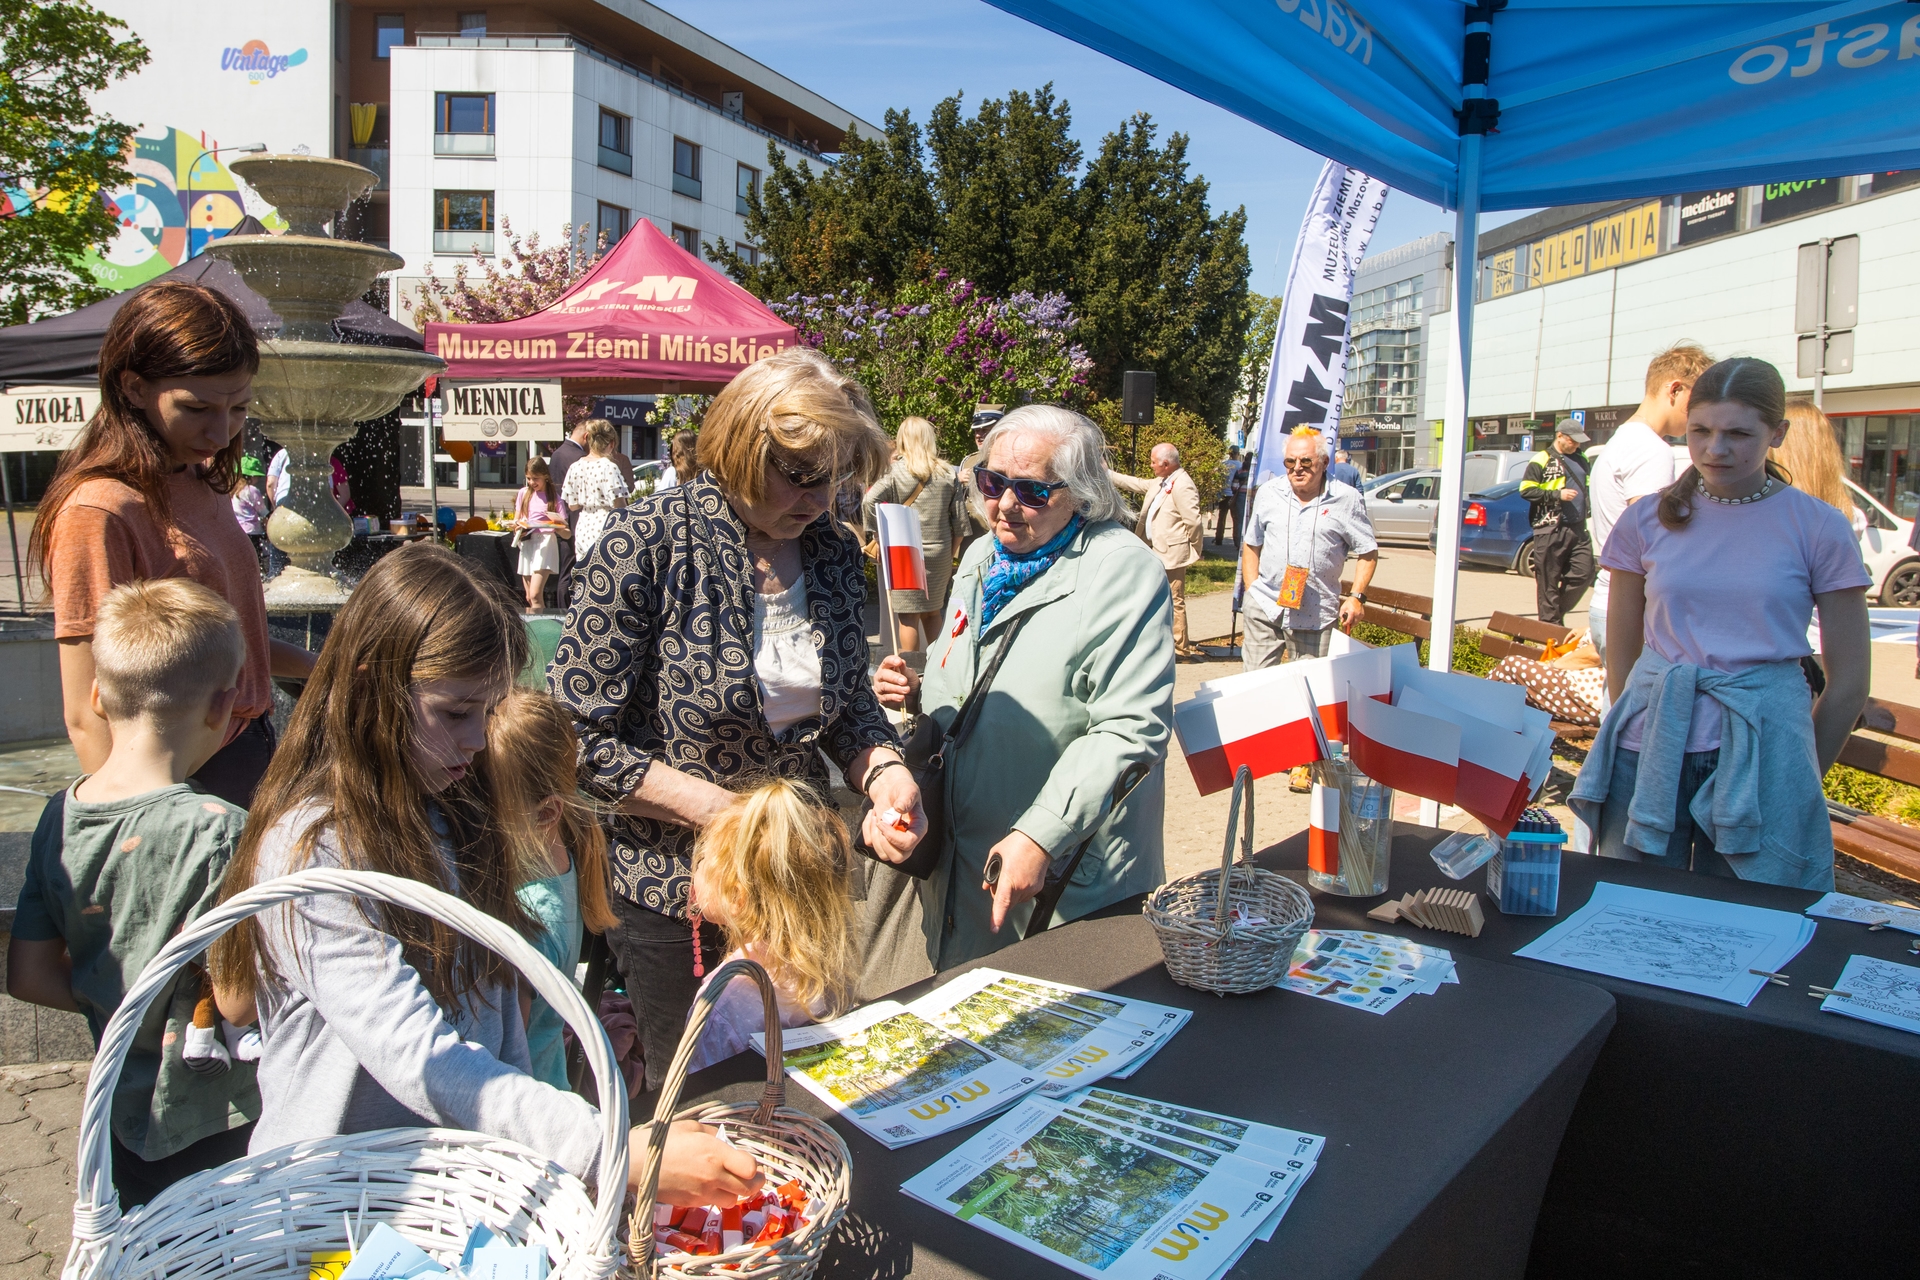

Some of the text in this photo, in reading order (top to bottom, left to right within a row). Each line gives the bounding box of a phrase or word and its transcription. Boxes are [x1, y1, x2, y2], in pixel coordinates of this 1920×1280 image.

[221, 47, 289, 79] Vintage
[248, 72, 265, 81] 600
[1681, 191, 1736, 219] medicine
[1323, 220, 1340, 282] MUZEUM
[1333, 177, 1353, 217] ZIEMI
[1533, 211, 1655, 278] SIŁOWNIA
[92, 263, 118, 282] 600
[1496, 258, 1514, 278] BEST
[633, 304, 692, 313] MIŃSKIEJ
[438, 332, 557, 360] Muzeum
[566, 332, 649, 360] Ziemi
[16, 397, 86, 425] SZKOŁA
[453, 387, 546, 416] MENNICA
[604, 405, 639, 420] PLAY
[1375, 422, 1401, 430] Homla
[1046, 1045, 1110, 1078] mim
[907, 1080, 991, 1121] mim
[1151, 1202, 1229, 1262] mim
[384, 1251, 402, 1272] Razem
